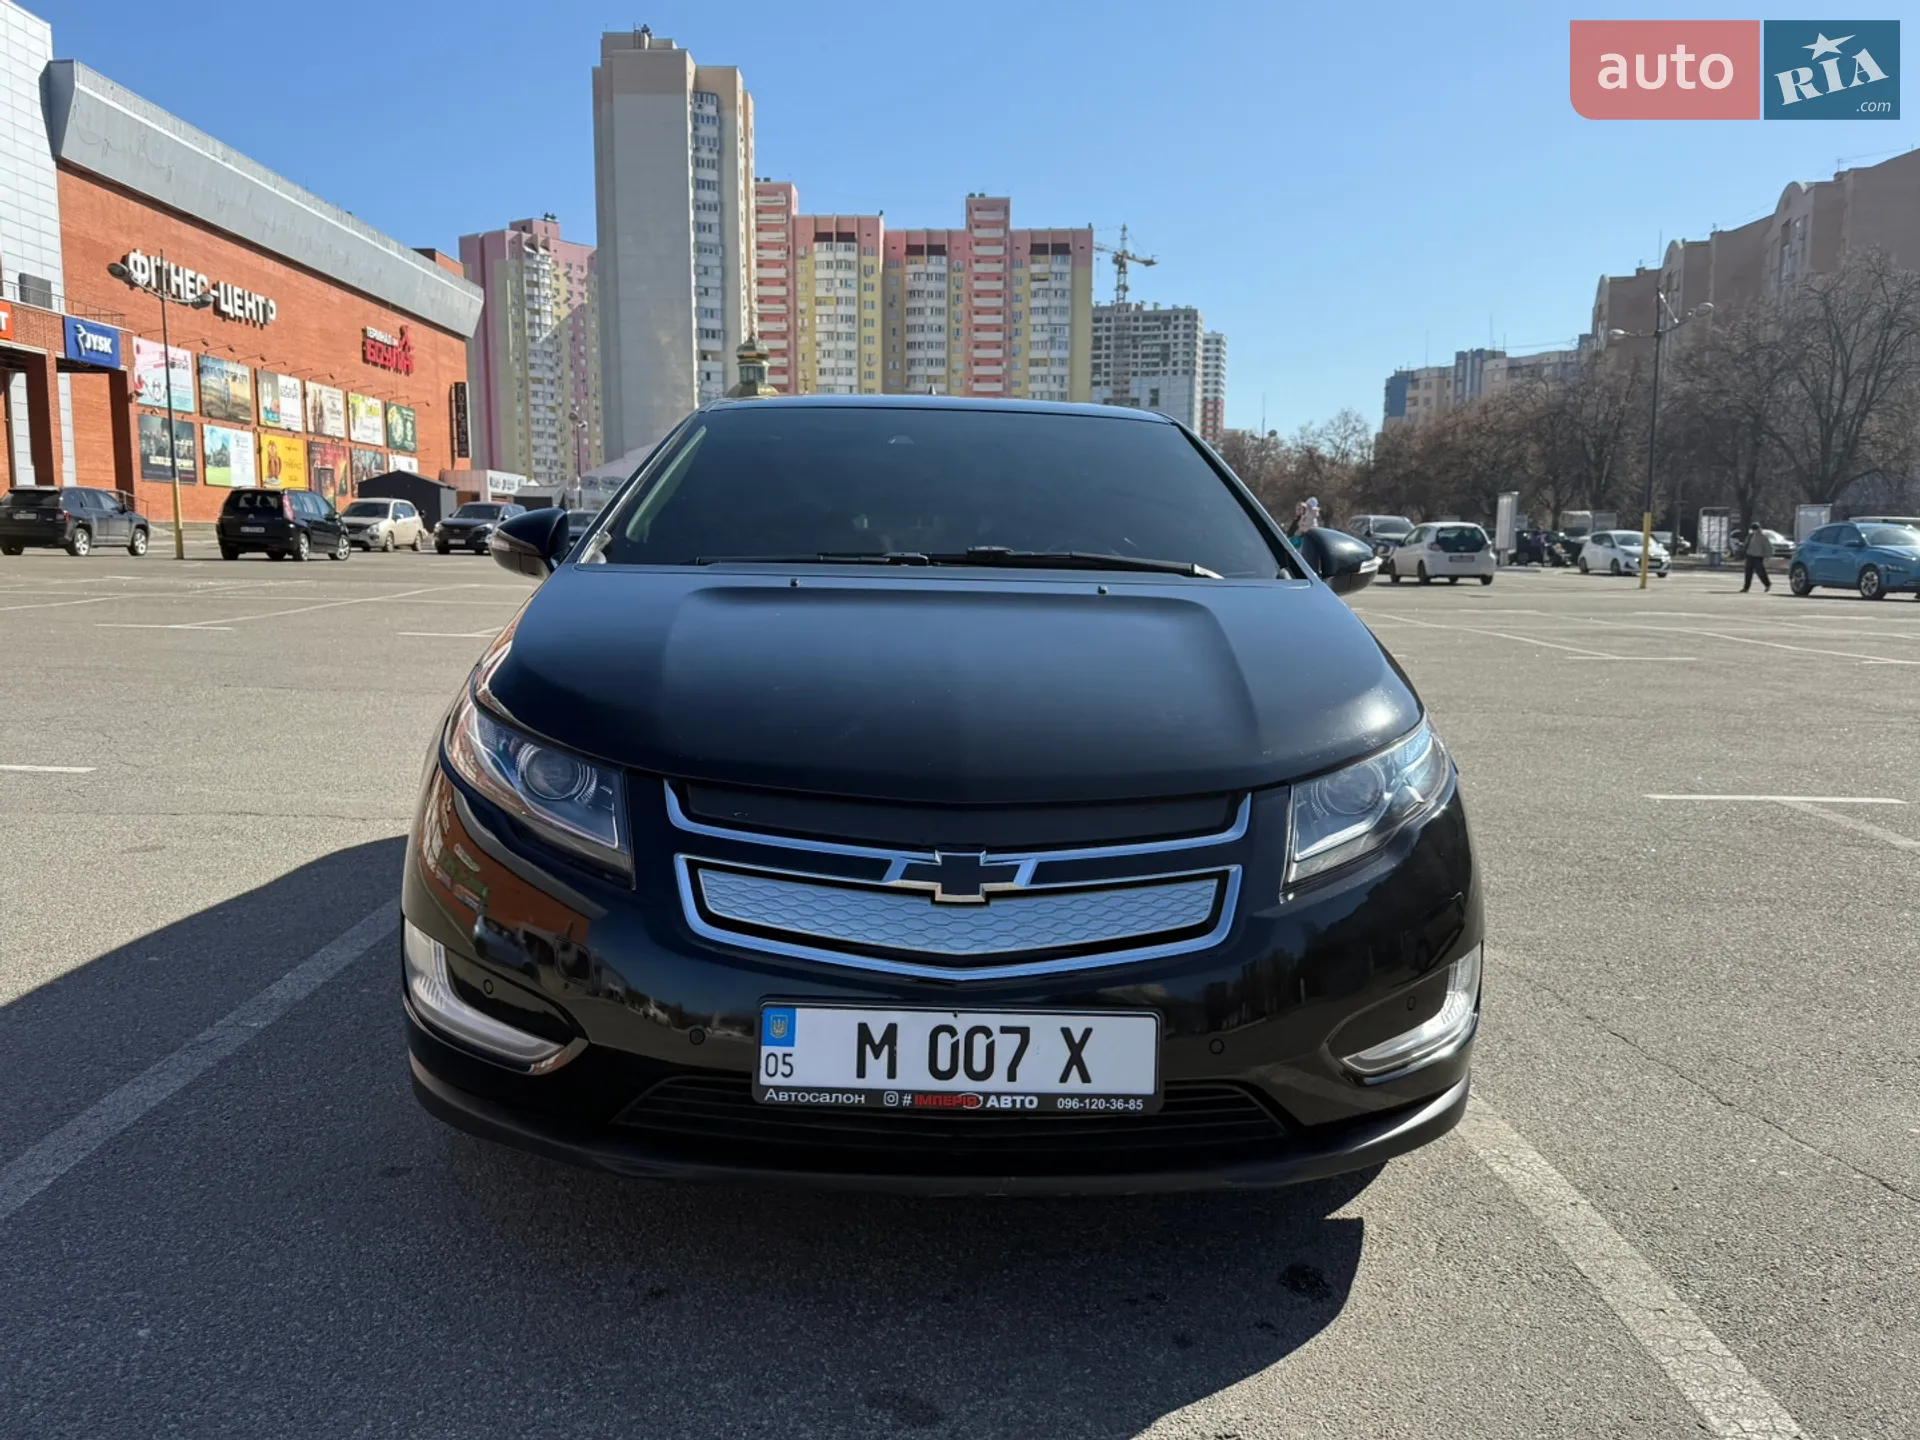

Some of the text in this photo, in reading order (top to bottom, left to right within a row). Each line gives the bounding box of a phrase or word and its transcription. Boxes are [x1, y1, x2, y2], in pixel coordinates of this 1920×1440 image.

[85, 333, 113, 354] JYSK
[765, 1052, 794, 1078] 05
[928, 1024, 1030, 1083] 007
[764, 1088, 866, 1104] Автосалон
[1057, 1097, 1144, 1111] 096-120-36-85
